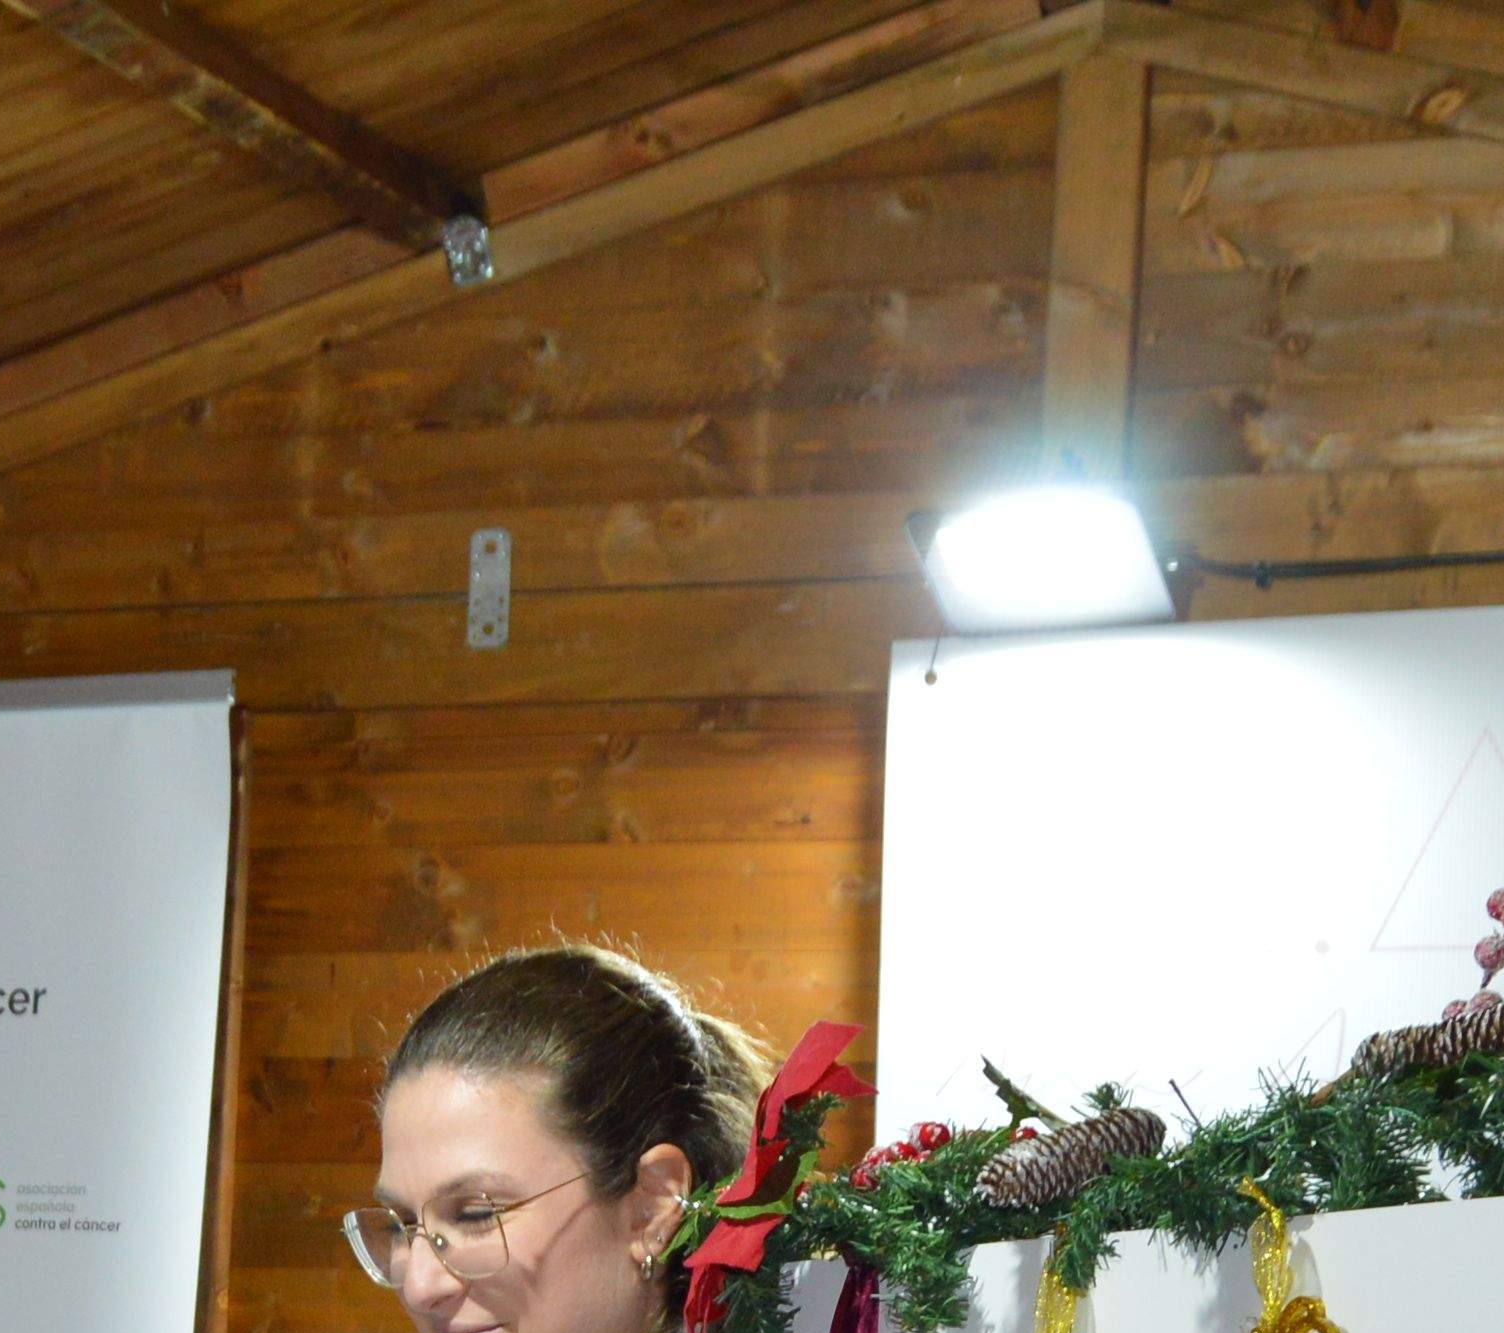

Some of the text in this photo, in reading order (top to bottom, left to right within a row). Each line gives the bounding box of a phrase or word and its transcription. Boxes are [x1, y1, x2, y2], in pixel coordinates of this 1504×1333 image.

[14, 1217, 123, 1233] contra el cáncer
